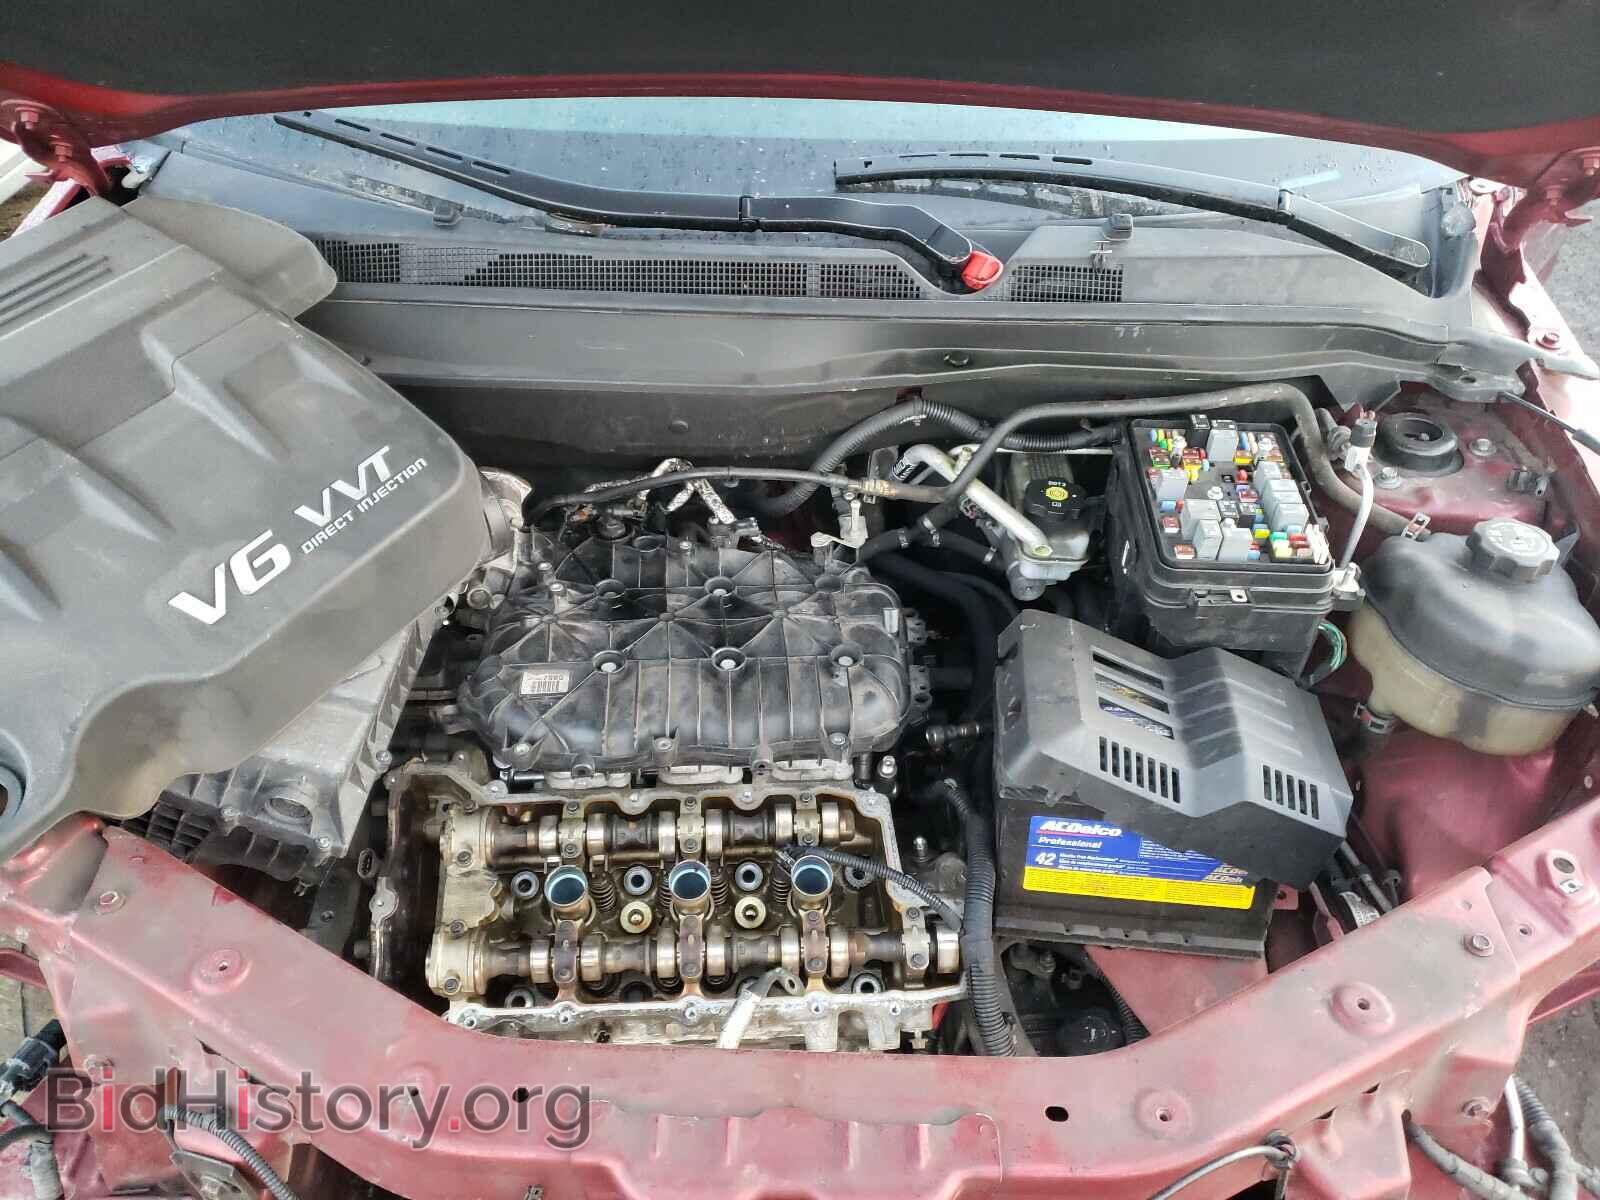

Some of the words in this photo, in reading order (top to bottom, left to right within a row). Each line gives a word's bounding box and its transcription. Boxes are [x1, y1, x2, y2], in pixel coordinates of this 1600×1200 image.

[300, 510, 355, 555] DIRECT
[357, 456, 429, 513] INJECTION
[168, 529, 292, 625] V6
[293, 445, 391, 527] VVT
[1037, 819, 1123, 838] ACDelco
[1037, 835, 1103, 850] Professional
[1034, 852, 1057, 866] 42
